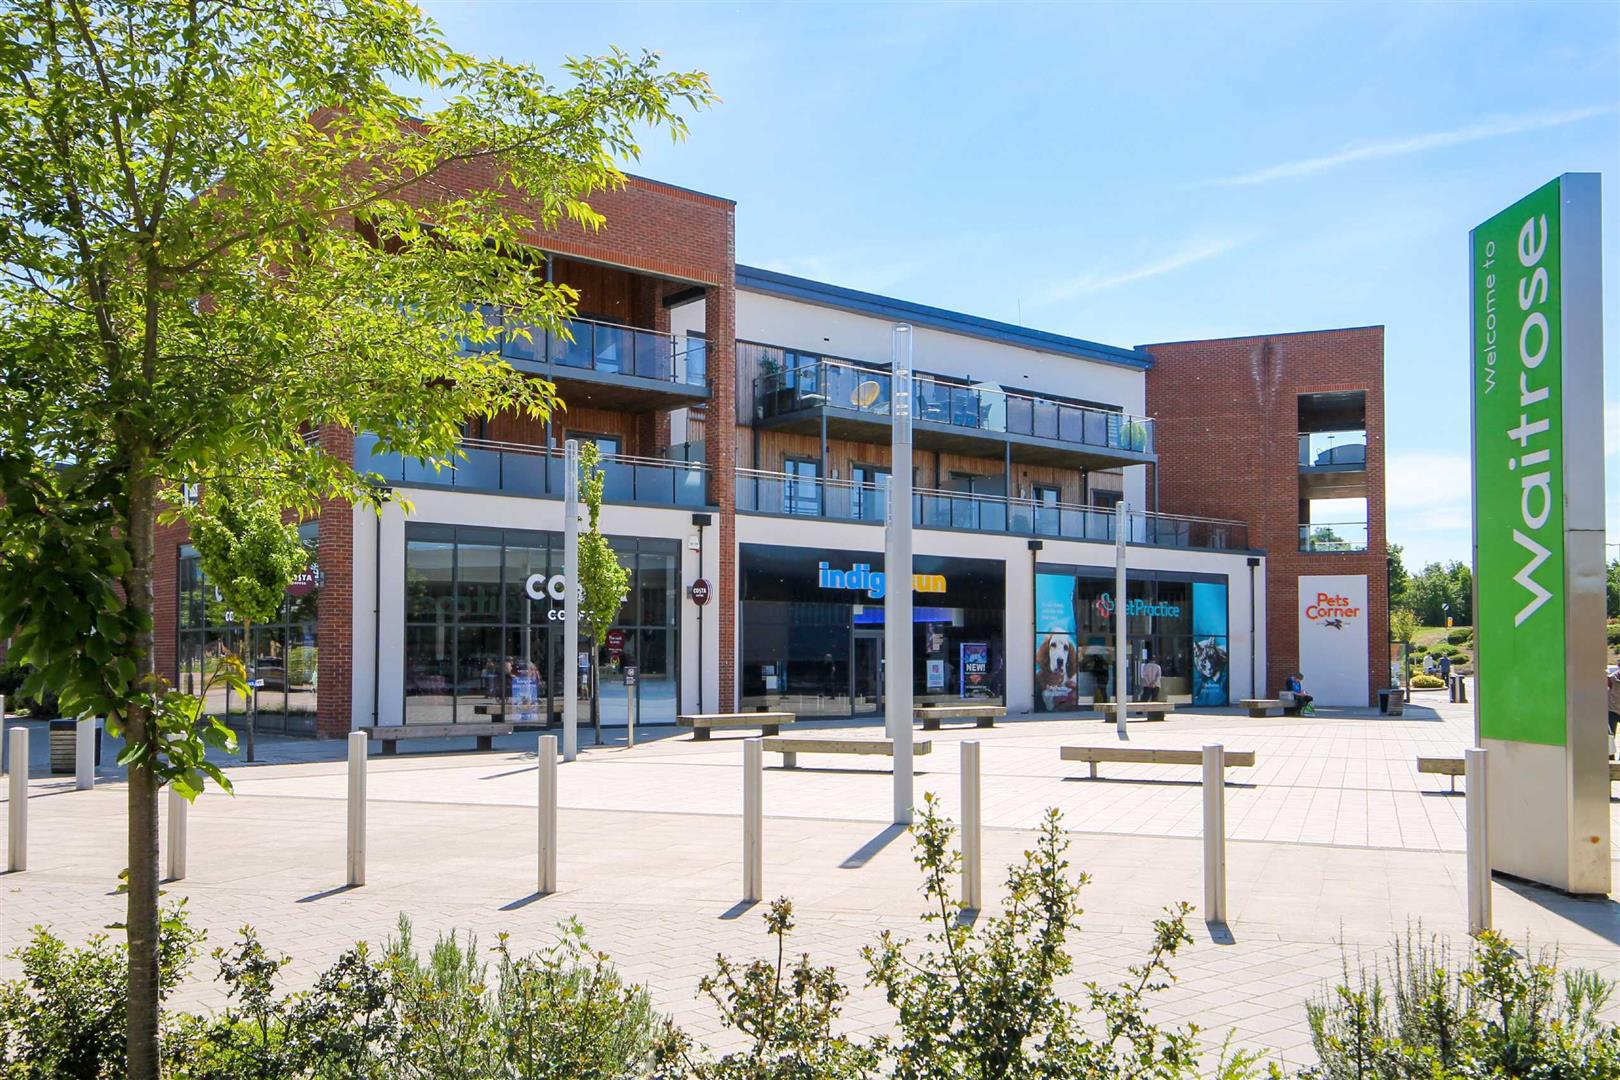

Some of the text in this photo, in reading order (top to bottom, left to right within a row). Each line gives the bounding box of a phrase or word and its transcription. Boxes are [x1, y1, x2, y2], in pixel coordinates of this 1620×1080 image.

[1482, 240, 1497, 394] Welcome to
[1506, 213, 1553, 628] Waitrose
[818, 560, 886, 599] indig
[1125, 598, 1181, 617] etPractice
[1317, 592, 1349, 606] Pets
[1305, 605, 1360, 620] Corner
[966, 663, 986, 672] NEW!
